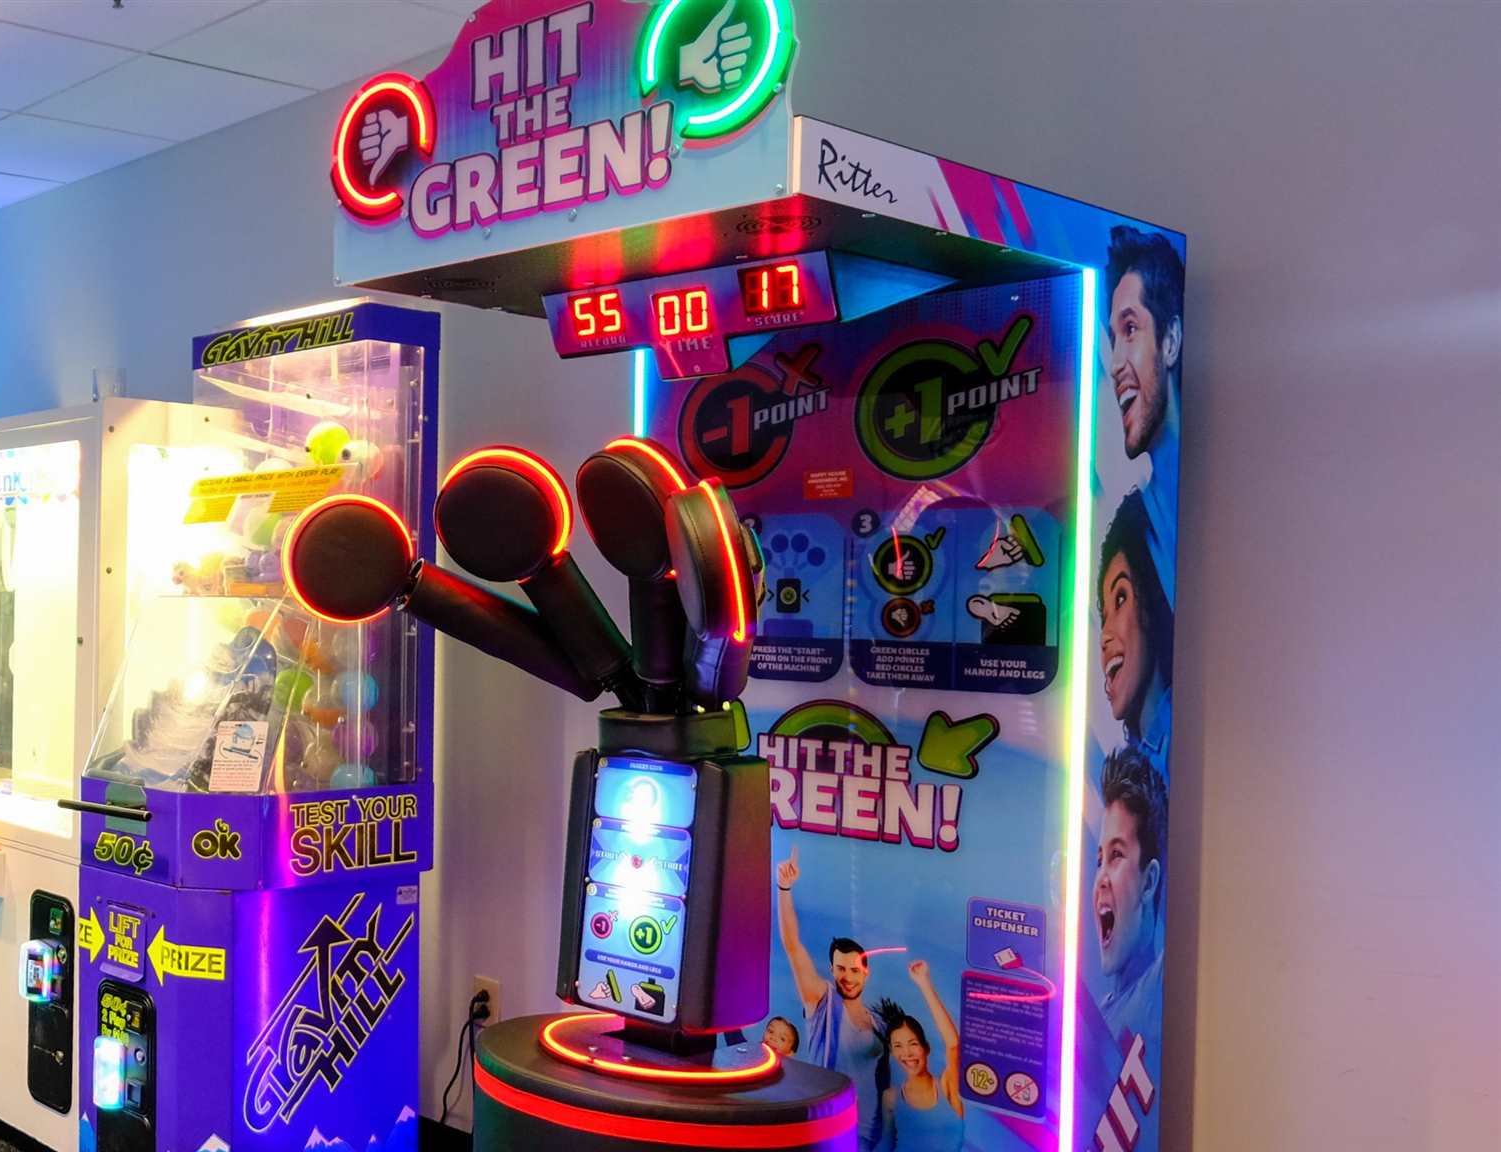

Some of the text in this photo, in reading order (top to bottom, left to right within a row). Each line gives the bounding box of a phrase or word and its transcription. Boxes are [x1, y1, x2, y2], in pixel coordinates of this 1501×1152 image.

[472, 2, 594, 108] HIT
[491, 85, 571, 147] THE
[409, 101, 673, 239] GREEN!
[818, 138, 898, 204] Ritter
[761, 264, 800, 310] 17
[573, 292, 622, 336] 55
[658, 290, 708, 336] 00
[753, 388, 830, 431] POINT
[885, 367, 1042, 445] +1 POINT
[858, 513, 874, 534] 3
[751, 653, 834, 665] UTTON ON THE FRONT
[752, 645, 777, 654] PRESS
[870, 646, 931, 656] GREEN CIRCLES
[875, 655, 925, 664] ADD POINTS
[980, 658, 1027, 669] USE YOUR
[783, 664, 821, 673] MACHINE
[866, 671, 936, 682] TAKE THEM AWAY
[892, 664, 925, 672] CIRCLES
[964, 667, 1046, 680] HANDS AND LEGS
[758, 733, 911, 781] HIT THE
[290, 794, 418, 830] TEST YOUR
[769, 766, 963, 851] REEN!
[93, 832, 154, 875] 50¢
[289, 818, 418, 878] SKILL
[108, 911, 141, 939] LIFT
[974, 917, 1039, 937] DISPENSER
[986, 906, 1027, 923] TICKET
[115, 932, 133, 951] FOR
[107, 944, 139, 969] PRIZE
[160, 945, 223, 974] PRIZE
